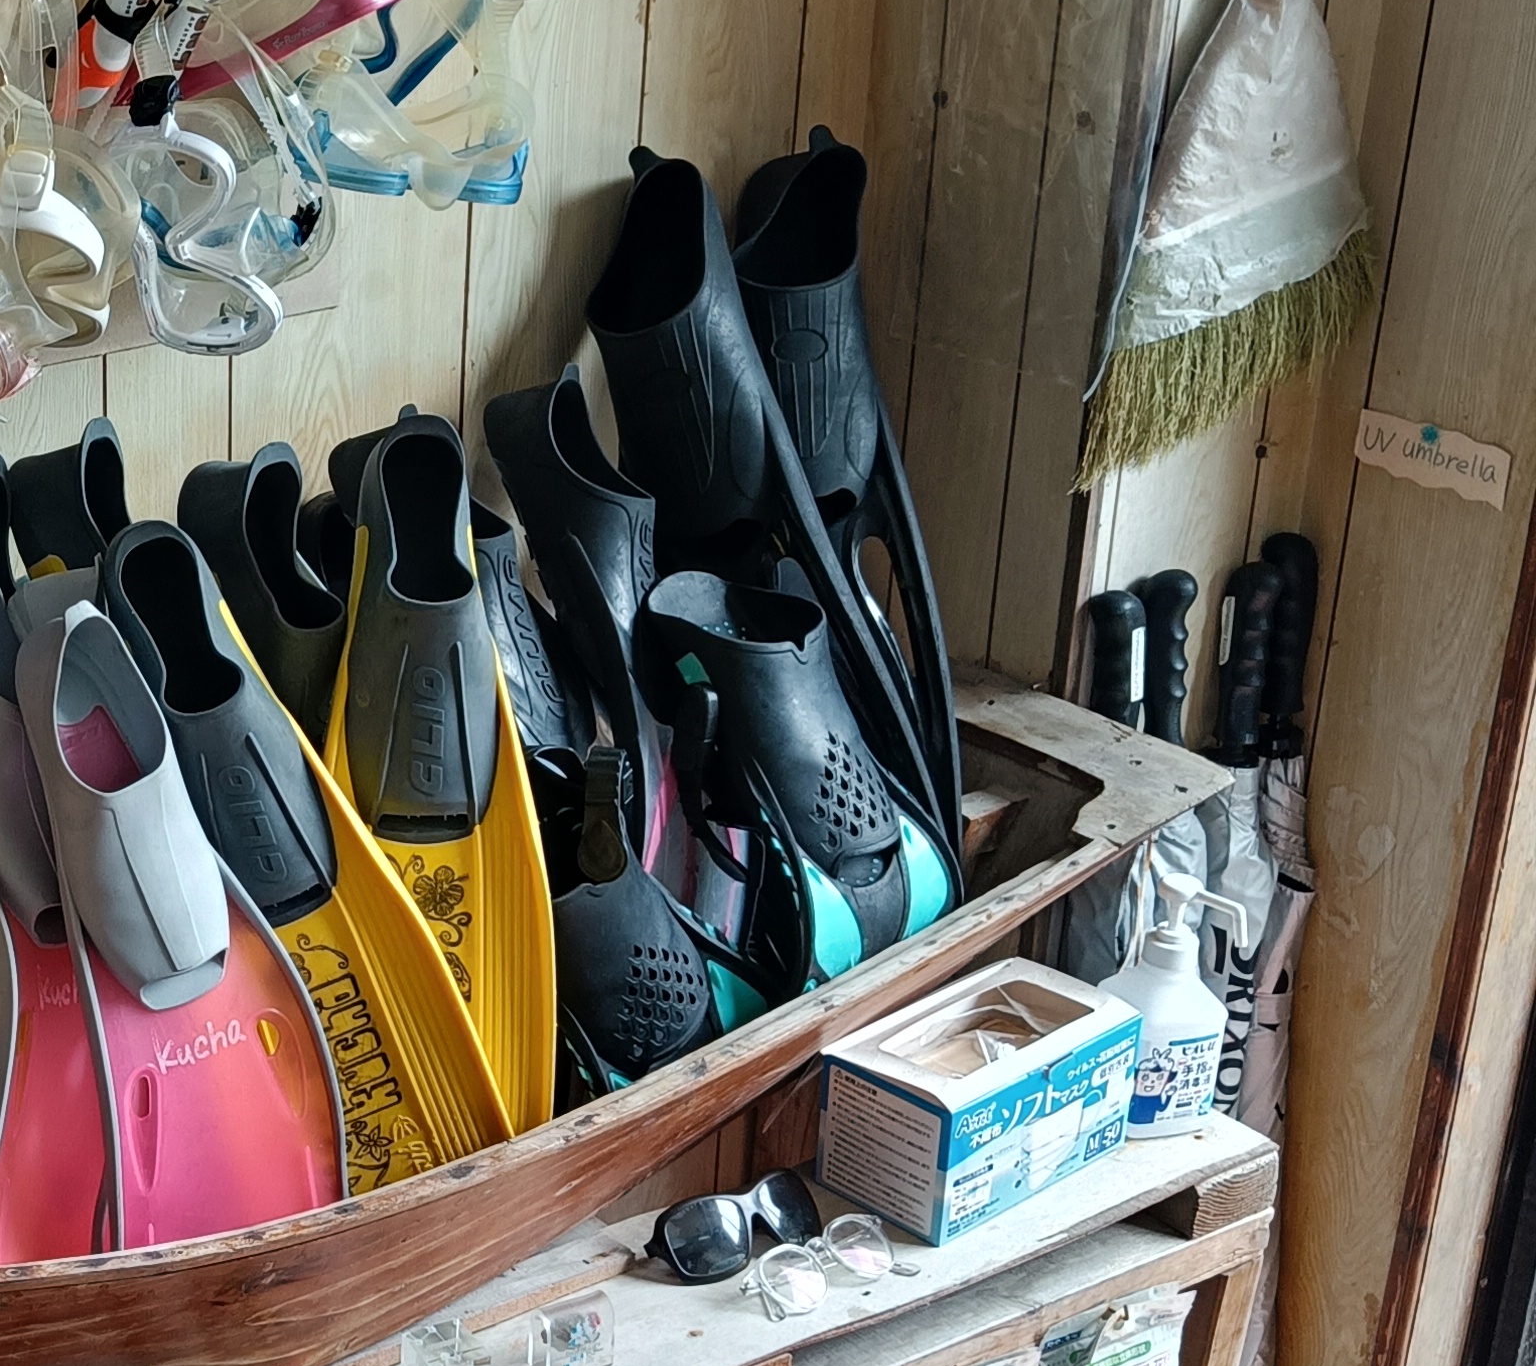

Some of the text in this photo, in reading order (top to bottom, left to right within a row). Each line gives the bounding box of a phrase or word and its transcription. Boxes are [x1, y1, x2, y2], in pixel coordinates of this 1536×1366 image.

[1363, 425, 1497, 485] UV umbrella
[1103, 1120, 1122, 1143] 50
